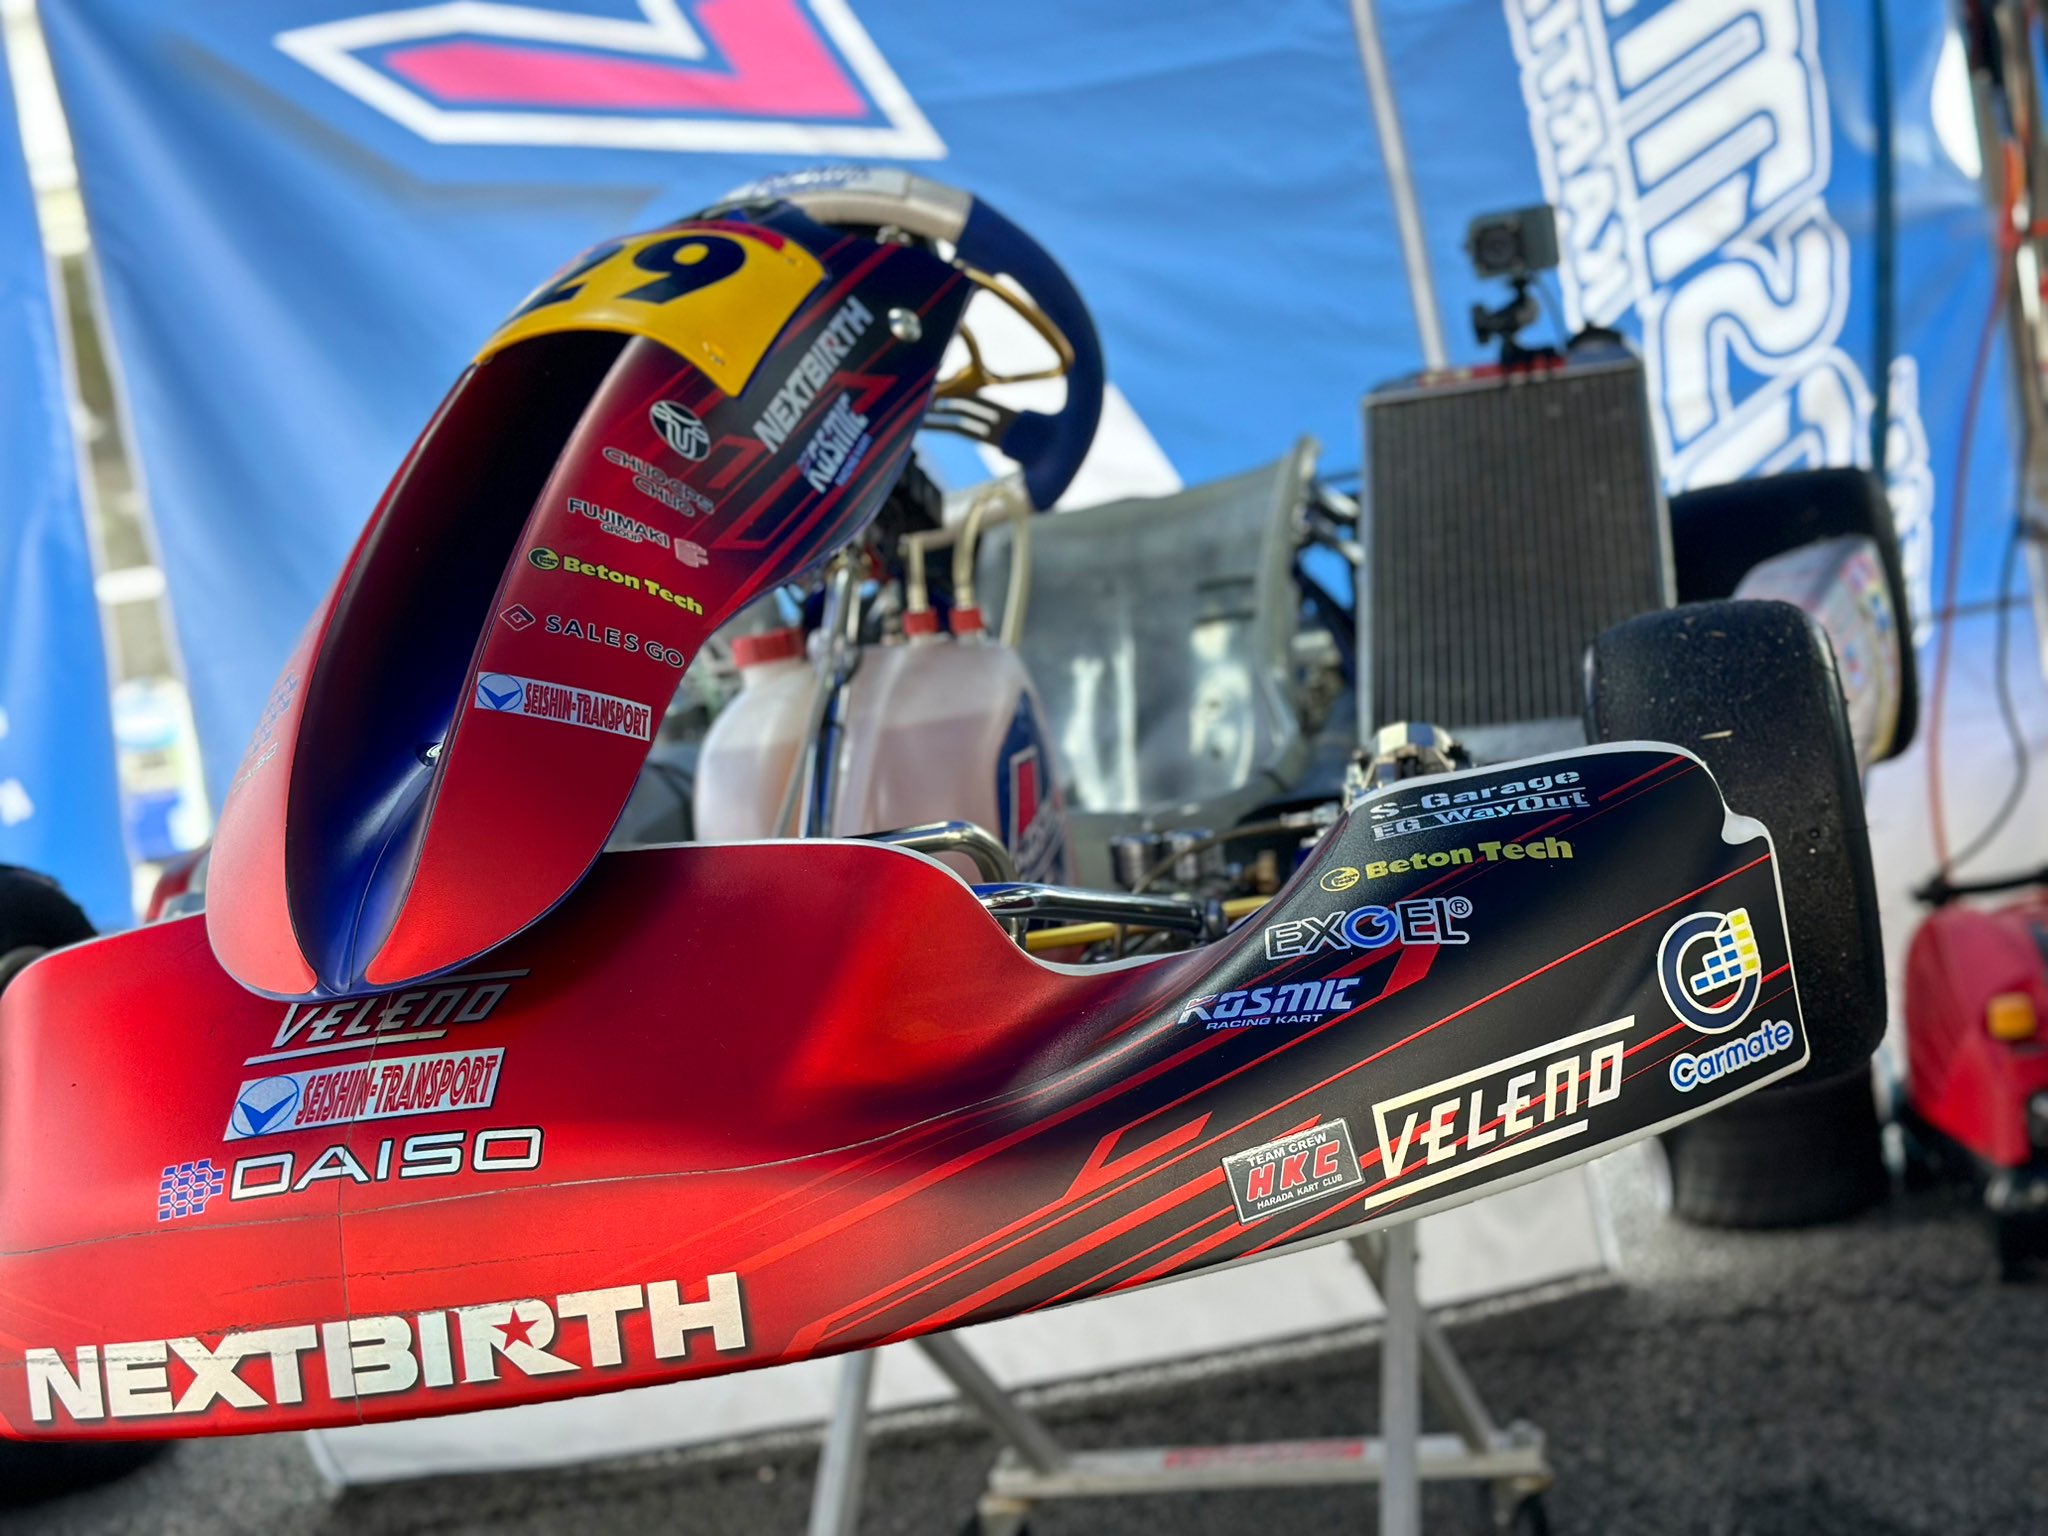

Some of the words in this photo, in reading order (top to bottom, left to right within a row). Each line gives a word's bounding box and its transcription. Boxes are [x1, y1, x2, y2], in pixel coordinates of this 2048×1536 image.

[752, 295, 875, 455] NEXTBIRTH
[602, 447, 668, 486] CHUO
[633, 475, 695, 517] CHUO
[567, 497, 671, 549] FUJIMAKI
[600, 521, 643, 543] GROUP
[563, 555, 640, 590] Beton
[644, 578, 704, 616] Tech
[545, 613, 640, 652] SALES
[644, 641, 685, 668] GO
[523, 682, 649, 738] SEISHIN-TRANSPORT
[1370, 770, 1580, 820] S-Garage
[1373, 817, 1421, 840] EG
[1434, 790, 1590, 826] WayOut
[1365, 847, 1474, 880] Beton
[1477, 836, 1574, 862] Tech
[271, 983, 510, 1050] VELENO
[1177, 977, 1361, 1025] KOSMIC
[1205, 1017, 1271, 1030] RACING
[1274, 1013, 1323, 1025] KART
[1671, 1021, 1793, 1090] Carmate
[295, 1054, 499, 1126] SEISHIN-TRANSPORT
[1370, 1038, 1627, 1182] VELENO
[229, 1126, 544, 1201] DAISO
[1248, 1147, 1286, 1167] TEAM
[1289, 1133, 1327, 1153] CREW
[1257, 1192, 1294, 1210] HARADA
[1297, 1182, 1319, 1196] KART
[1323, 1174, 1343, 1187] CLUB
[24, 1271, 747, 1422] NEXTBIRTH
